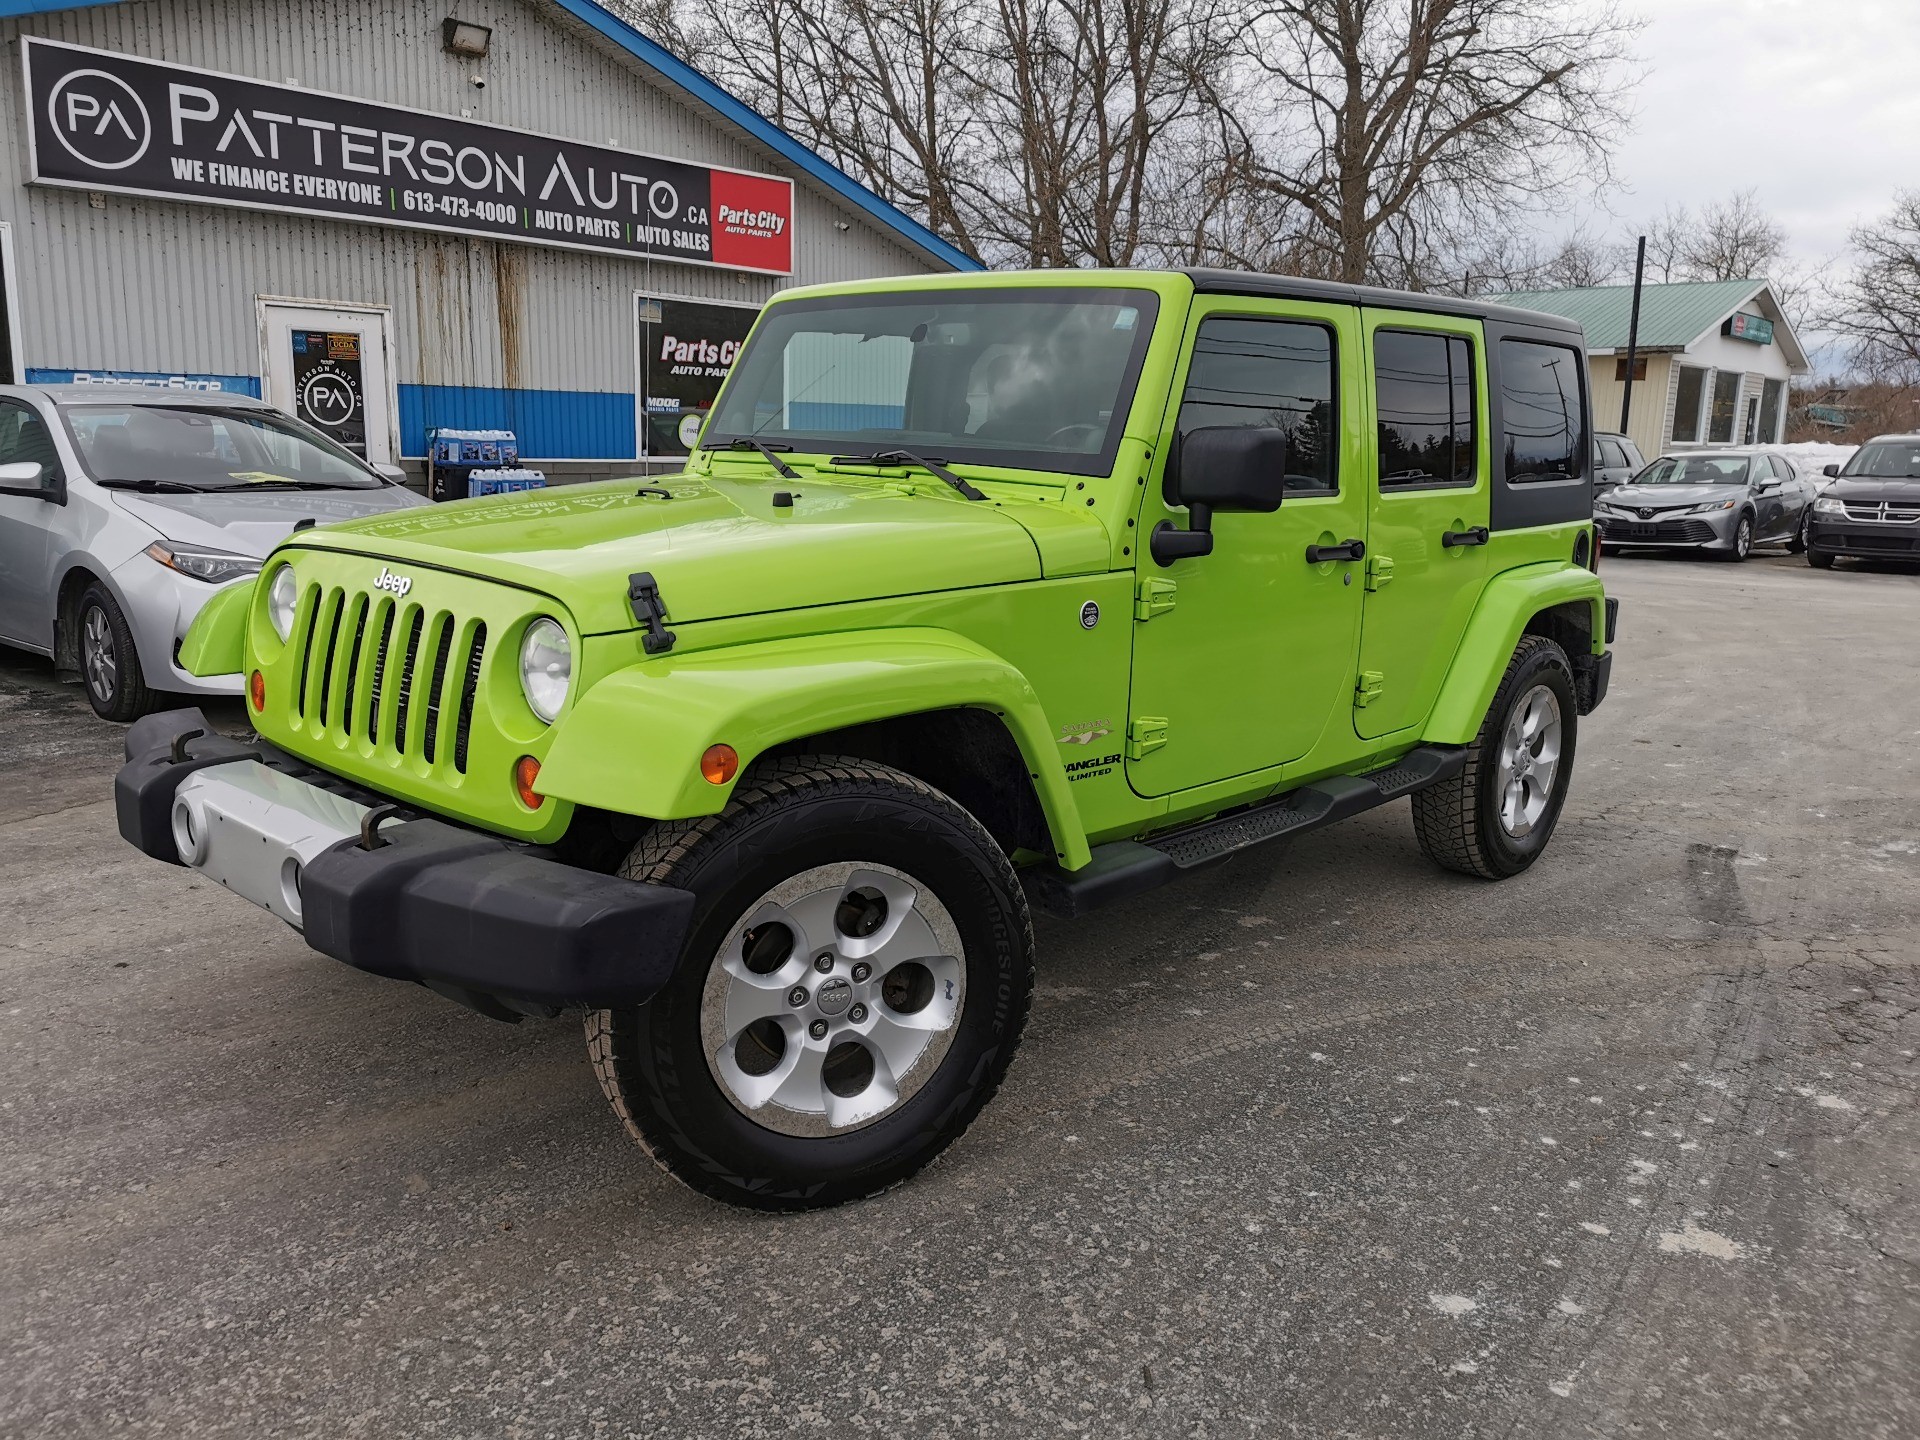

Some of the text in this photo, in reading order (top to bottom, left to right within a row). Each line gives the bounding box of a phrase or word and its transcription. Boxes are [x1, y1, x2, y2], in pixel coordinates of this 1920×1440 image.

[66, 92, 137, 141] PA
[168, 82, 526, 197] PATTERSON
[539, 151, 679, 220] AUTO
[171, 156, 383, 206] WE FINANCE EVERYONE
[403, 188, 517, 225] 613-473-4000
[535, 209, 620, 239] AUTO PARTS
[636, 224, 710, 252] AUTO SALES
[724, 225, 772, 238] AUTO PARTS
[333, 341, 354, 349] UCDA
[660, 335, 741, 365] PartsCi
[670, 365, 730, 377] AUTO PAR
[296, 365, 330, 406] PATTERSON
[334, 367, 357, 387] AUTO
[312, 386, 348, 409] PA
[646, 396, 680, 408] MOOG
[373, 567, 412, 598] Jeep
[1062, 718, 1112, 733] SAHARA
[1064, 753, 1122, 773] ANGLER
[1068, 767, 1112, 782] LIMITED
